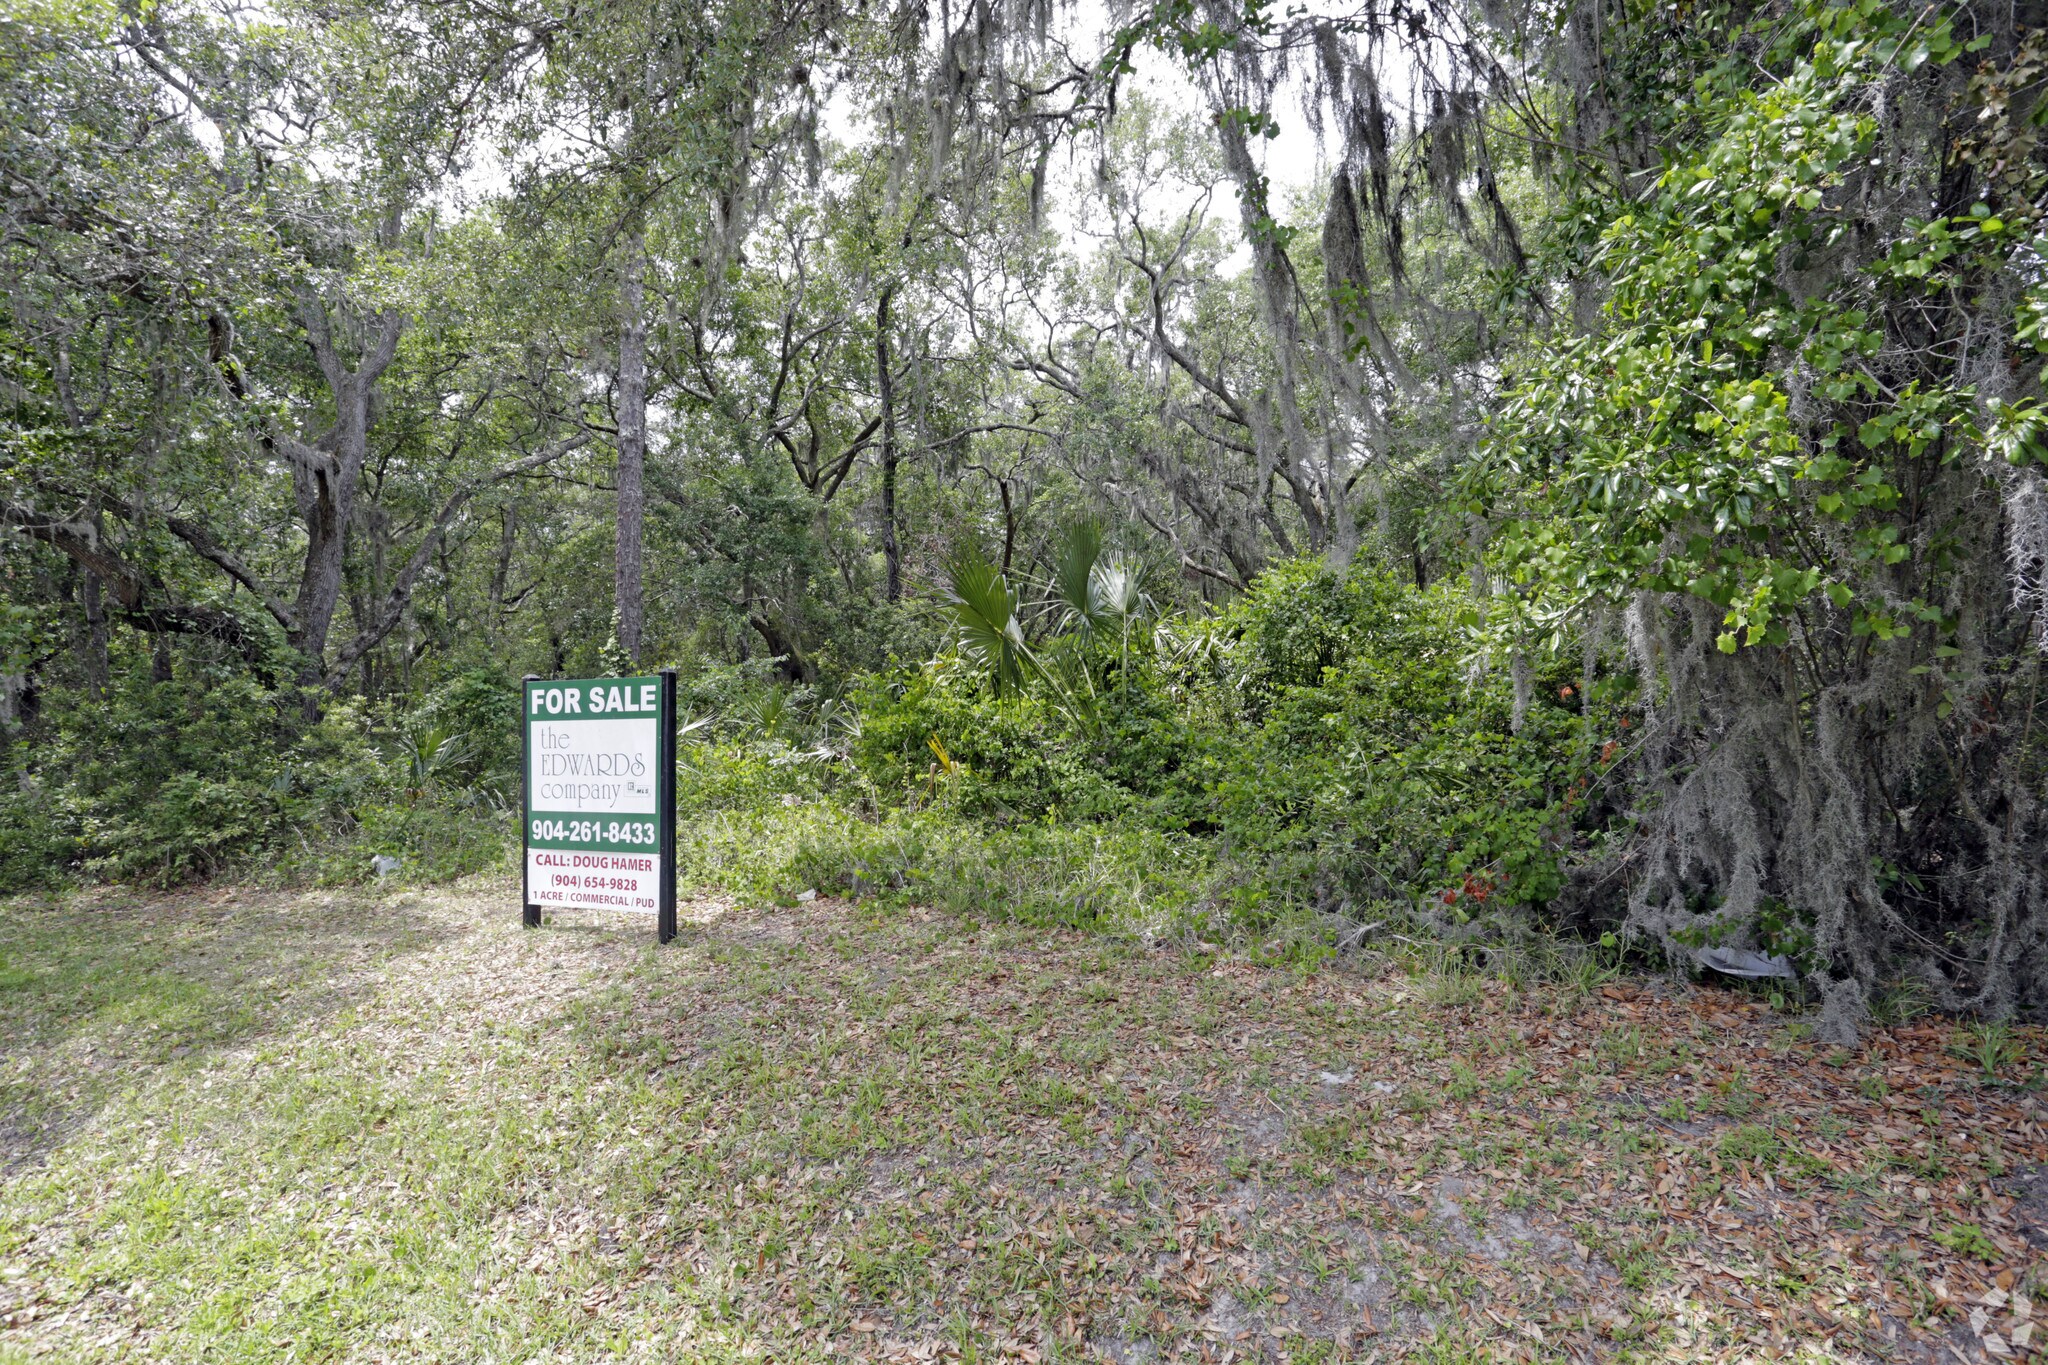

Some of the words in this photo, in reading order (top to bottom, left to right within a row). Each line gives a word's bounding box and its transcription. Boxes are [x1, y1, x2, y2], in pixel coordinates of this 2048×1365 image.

[531, 688, 582, 715] FOR
[588, 685, 657, 713] SALE
[541, 726, 570, 749] the
[541, 753, 645, 777] EDWARDS
[541, 783, 621, 808] company
[532, 820, 655, 844] 904-261-8433
[536, 854, 570, 867] CALL:
[573, 856, 609, 869] DOUG
[611, 857, 652, 872] HAMER
[551, 874, 581, 889] (904)
[584, 876, 638, 891] 654-9828
[533, 891, 537, 899] 1
[540, 891, 563, 901] ACRE
[570, 892, 629, 906] COMMERCIAL
[636, 898, 655, 908] PUD
